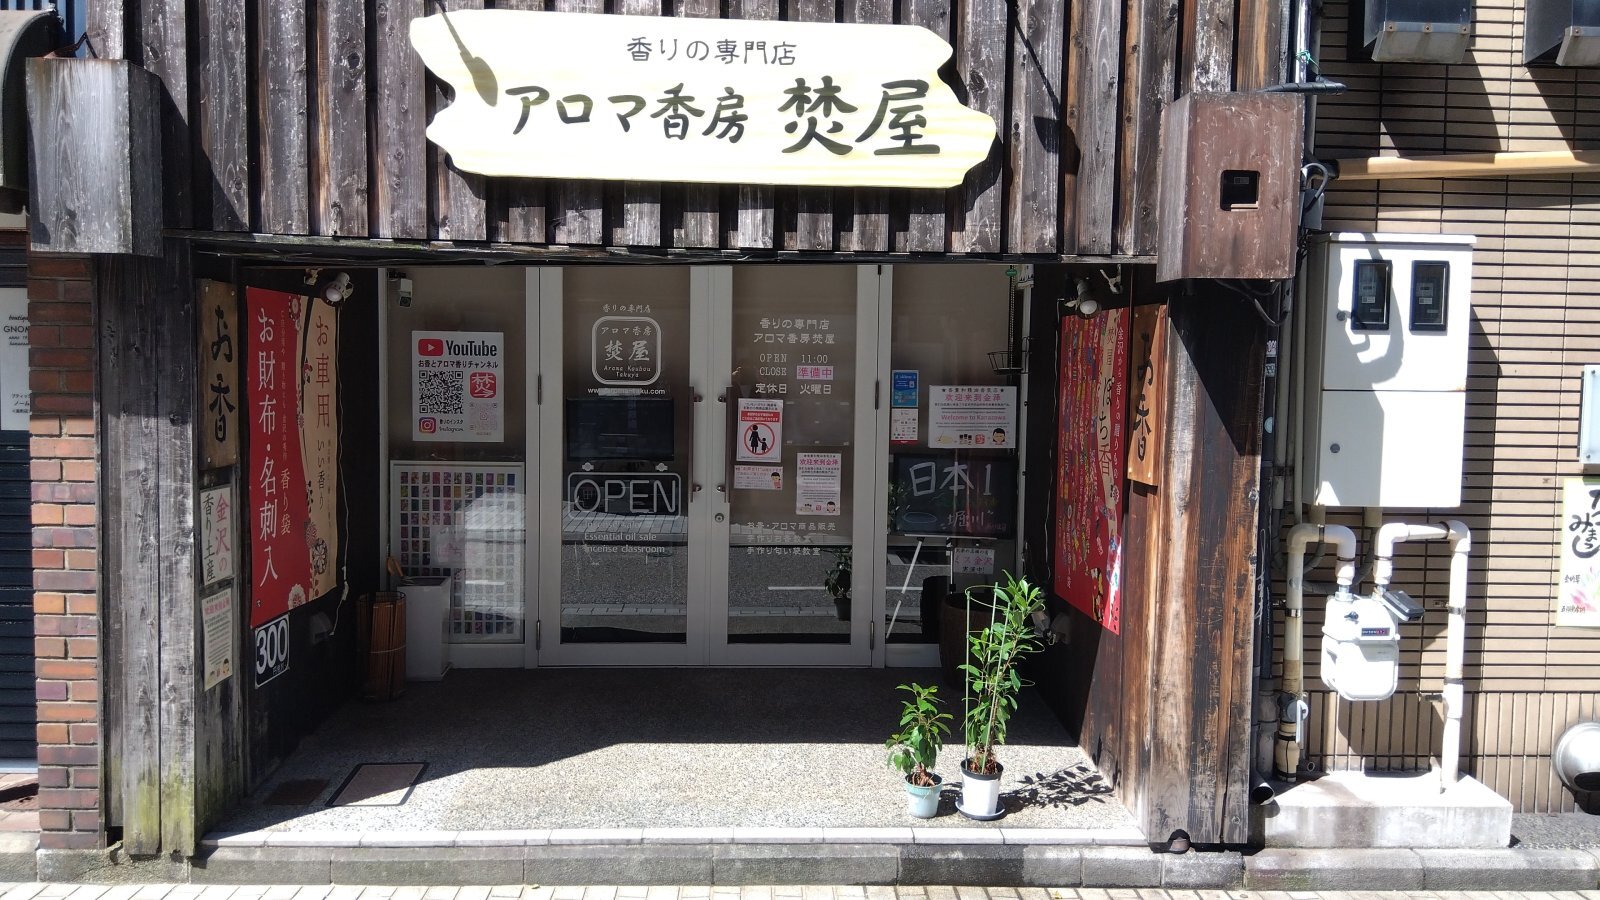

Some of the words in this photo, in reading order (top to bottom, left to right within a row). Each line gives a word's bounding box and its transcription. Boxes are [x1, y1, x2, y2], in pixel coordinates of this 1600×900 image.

[626, 36, 798, 66] 香りの専門店
[504, 82, 749, 144] アロマ香房
[776, 75, 942, 156] 焚屋
[602, 303, 651, 313] 香りの専門店
[600, 325, 652, 336] アロマ香房
[759, 317, 830, 330] 香りの専門店
[753, 333, 835, 344] アロマ香房焚屋
[446, 340, 498, 357] YouTube
[604, 339, 650, 361] 焚屋
[418, 359, 499, 369] お香とアロマ香りチャンネル
[759, 353, 787, 363] OPEN
[801, 354, 828, 363] 11:00
[209, 304, 236, 443] お香
[315, 315, 330, 429] お車用
[759, 367, 787, 376] CLOSE
[798, 367, 832, 379] 準備中
[755, 383, 787, 394] 定休日
[799, 384, 832, 395] 火曜日
[1132, 331, 1154, 462] お香
[317, 439, 325, 511] いい香り
[280, 468, 291, 536] 香り袋
[574, 479, 676, 513] OPEN
[215, 494, 231, 572] 金沢の
[747, 521, 836, 530] お香・アロマ商品販売
[203, 492, 216, 582] 香り土産
[584, 533, 623, 541] Essential
[625, 533, 636, 541] oil
[639, 533, 657, 541] sale
[621, 545, 665, 553] classroom
[256, 619, 288, 675] 300
